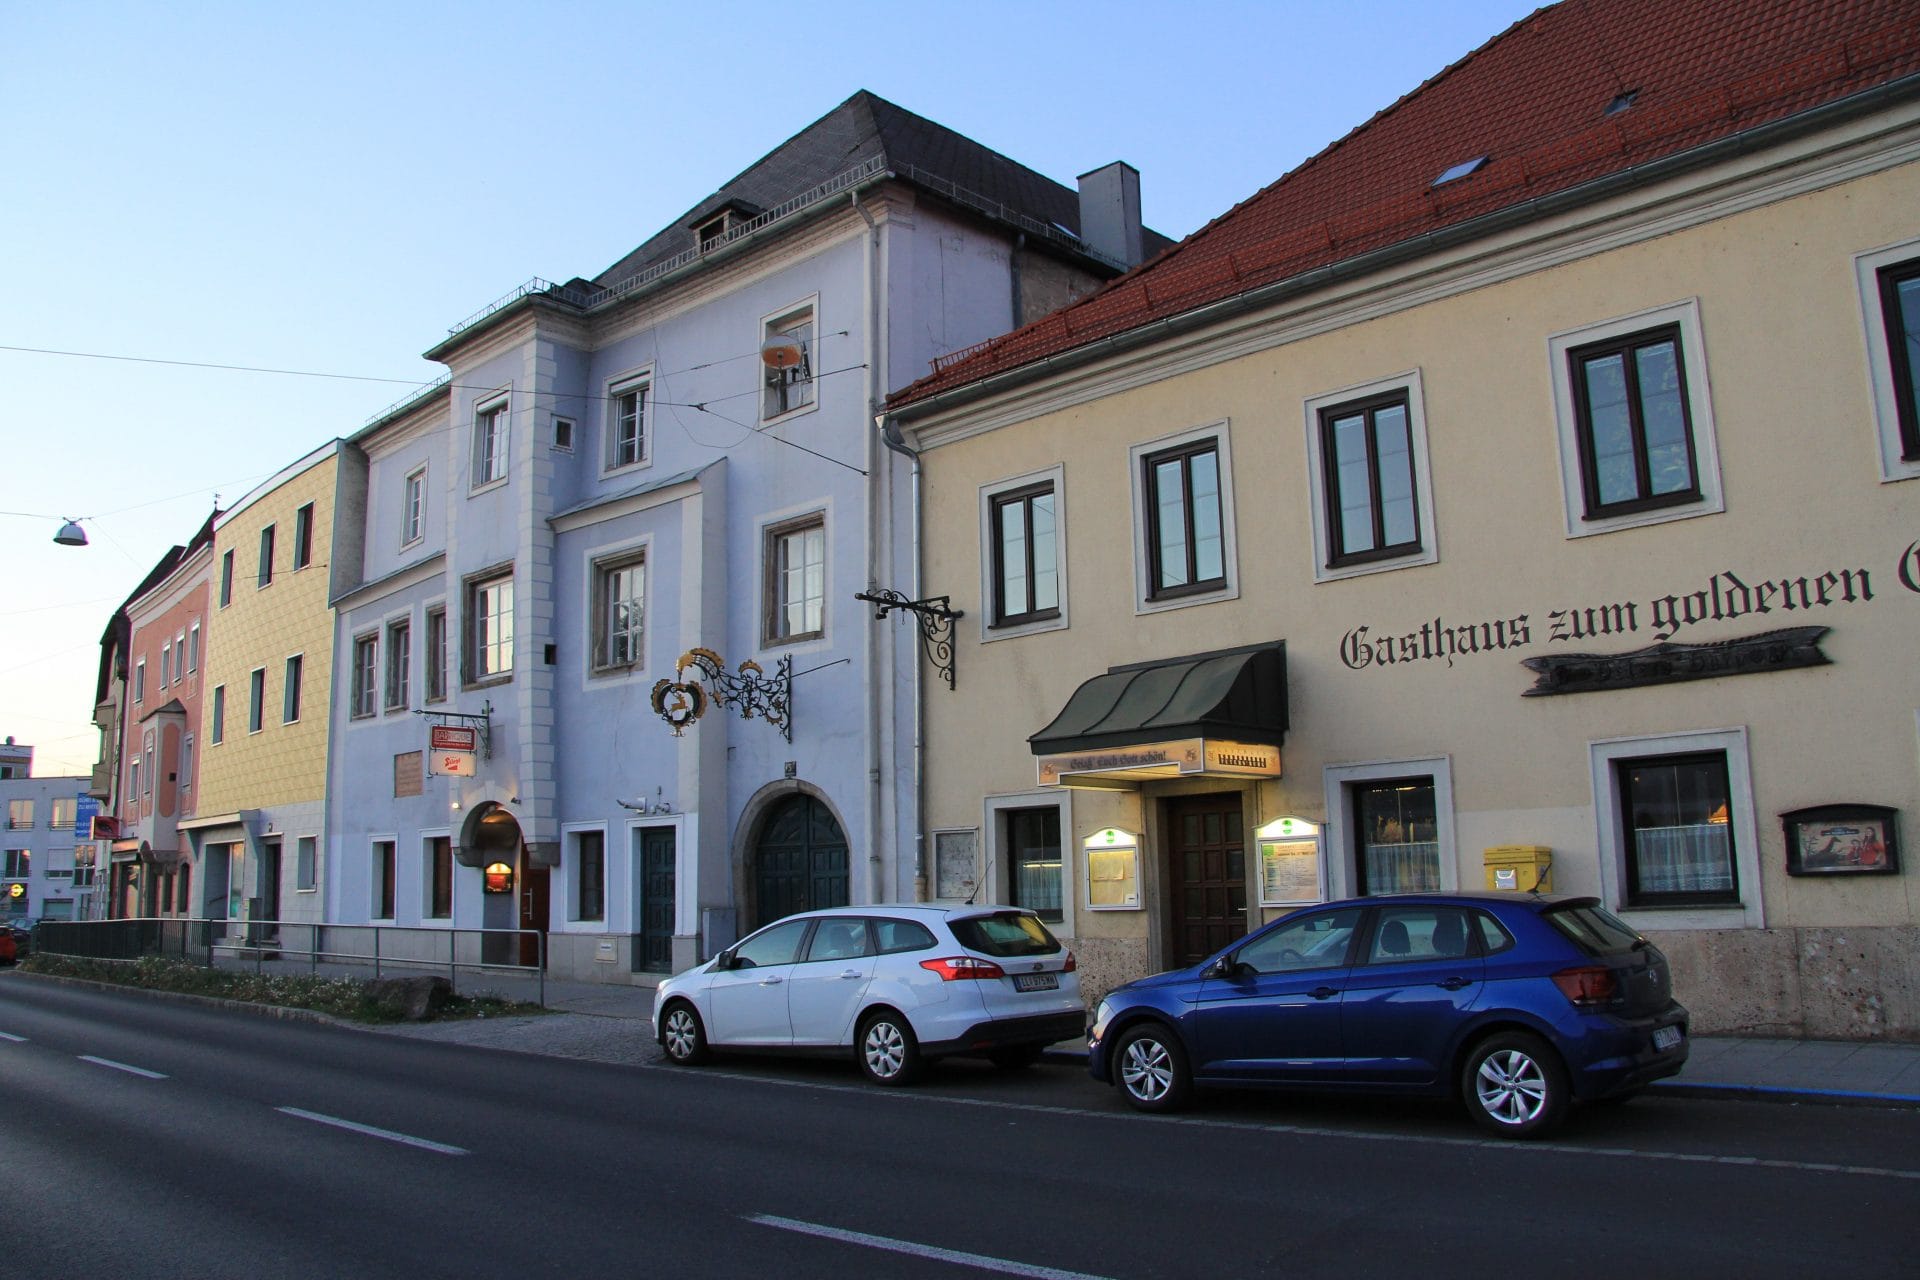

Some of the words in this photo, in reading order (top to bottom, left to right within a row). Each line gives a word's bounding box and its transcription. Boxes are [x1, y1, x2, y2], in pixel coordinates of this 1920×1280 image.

[1339, 614, 1531, 669] Gasthaus
[1548, 601, 1638, 643] zum
[1651, 568, 1876, 641] goldenen
